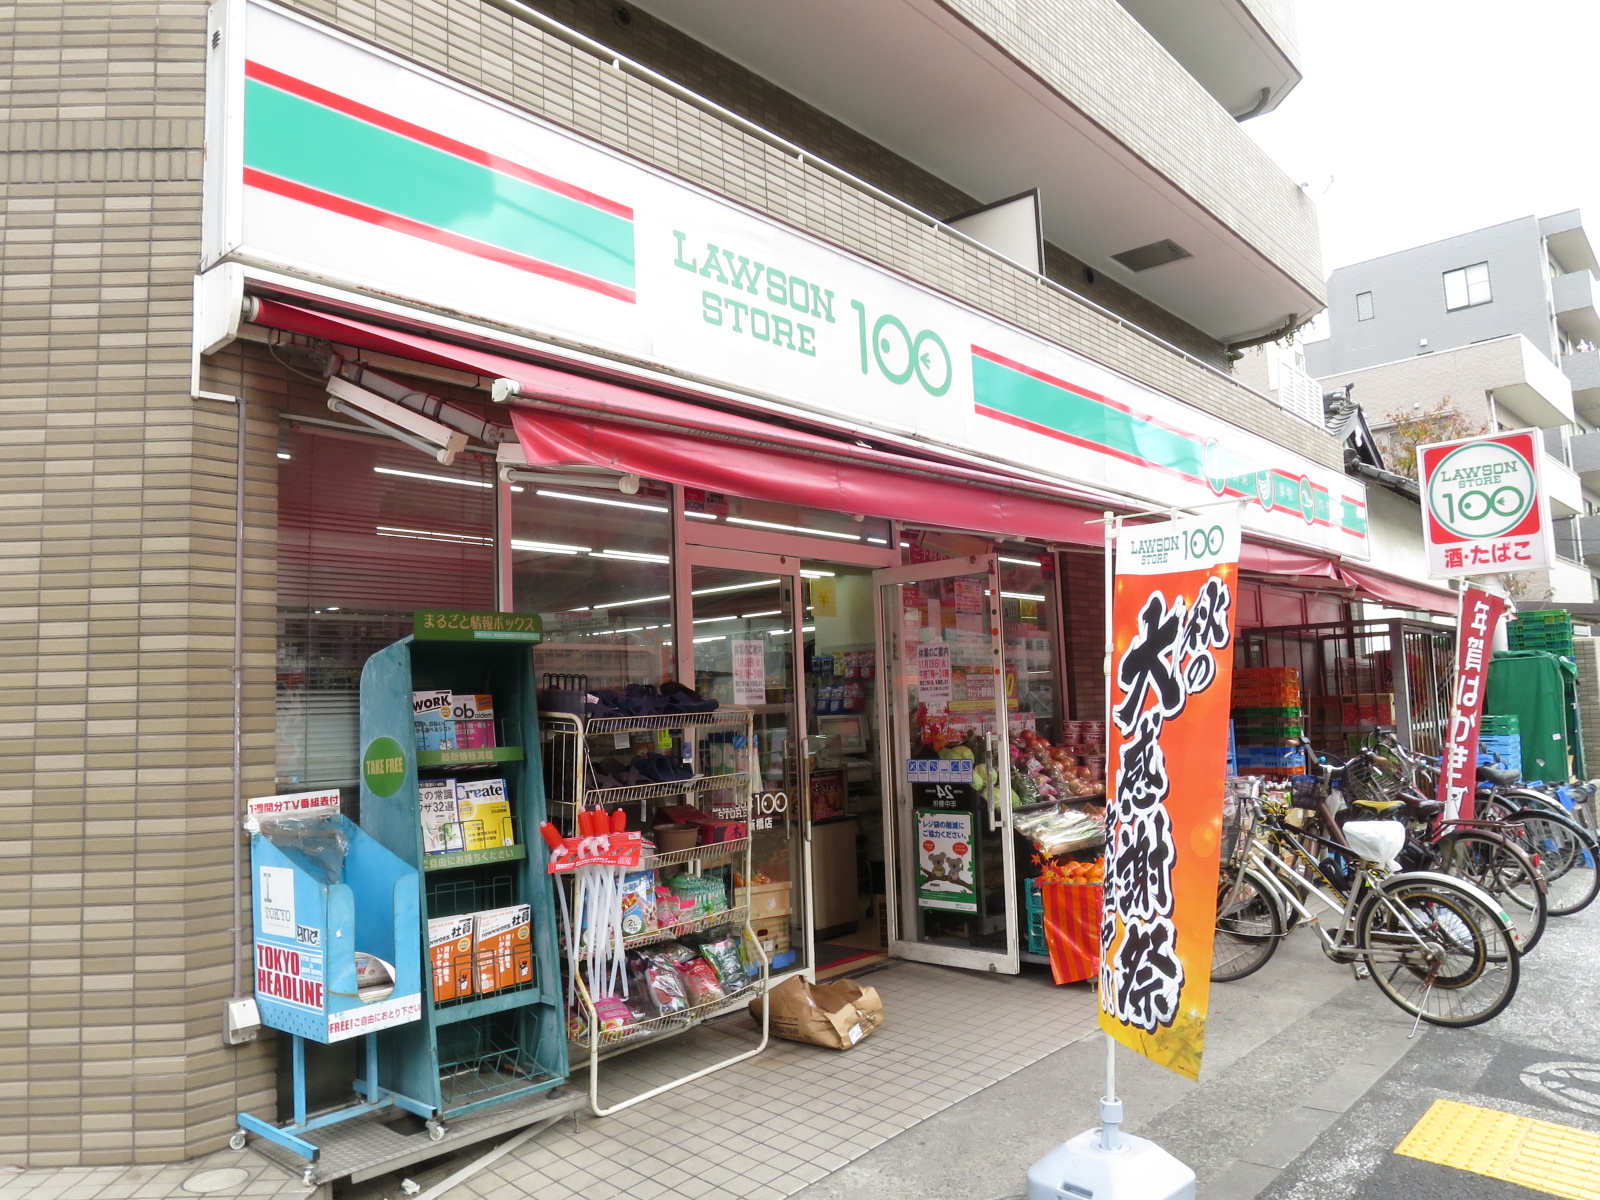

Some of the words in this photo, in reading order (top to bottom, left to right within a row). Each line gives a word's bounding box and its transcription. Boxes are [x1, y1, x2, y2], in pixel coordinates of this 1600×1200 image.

[673, 229, 836, 324] LAWSON
[702, 290, 817, 357] STORE
[850, 299, 953, 397] 100
[1441, 460, 1519, 483] LAWSON
[1458, 475, 1502, 489] STORE
[1442, 485, 1525, 524] 100
[1130, 535, 1180, 555] LAWSON
[1141, 552, 1169, 565] STORE
[1182, 524, 1225, 561] 100
[1444, 541, 1532, 569] 酒・たばこ
[423, 613, 536, 632] まるごと情報ボックス
[1180, 577, 1230, 694] 秋の
[366, 758, 385, 776] TAKE
[385, 757, 404, 775] FREE
[249, 795, 339, 814] 1週間分TV番組表付
[456, 784, 504, 801] Create
[718, 808, 748, 820] STORE
[1113, 590, 1187, 1034] 大感謝祭
[264, 906, 291, 922] TOKYO
[257, 943, 300, 977] TOKYO
[257, 967, 323, 1009] HEADLINE
